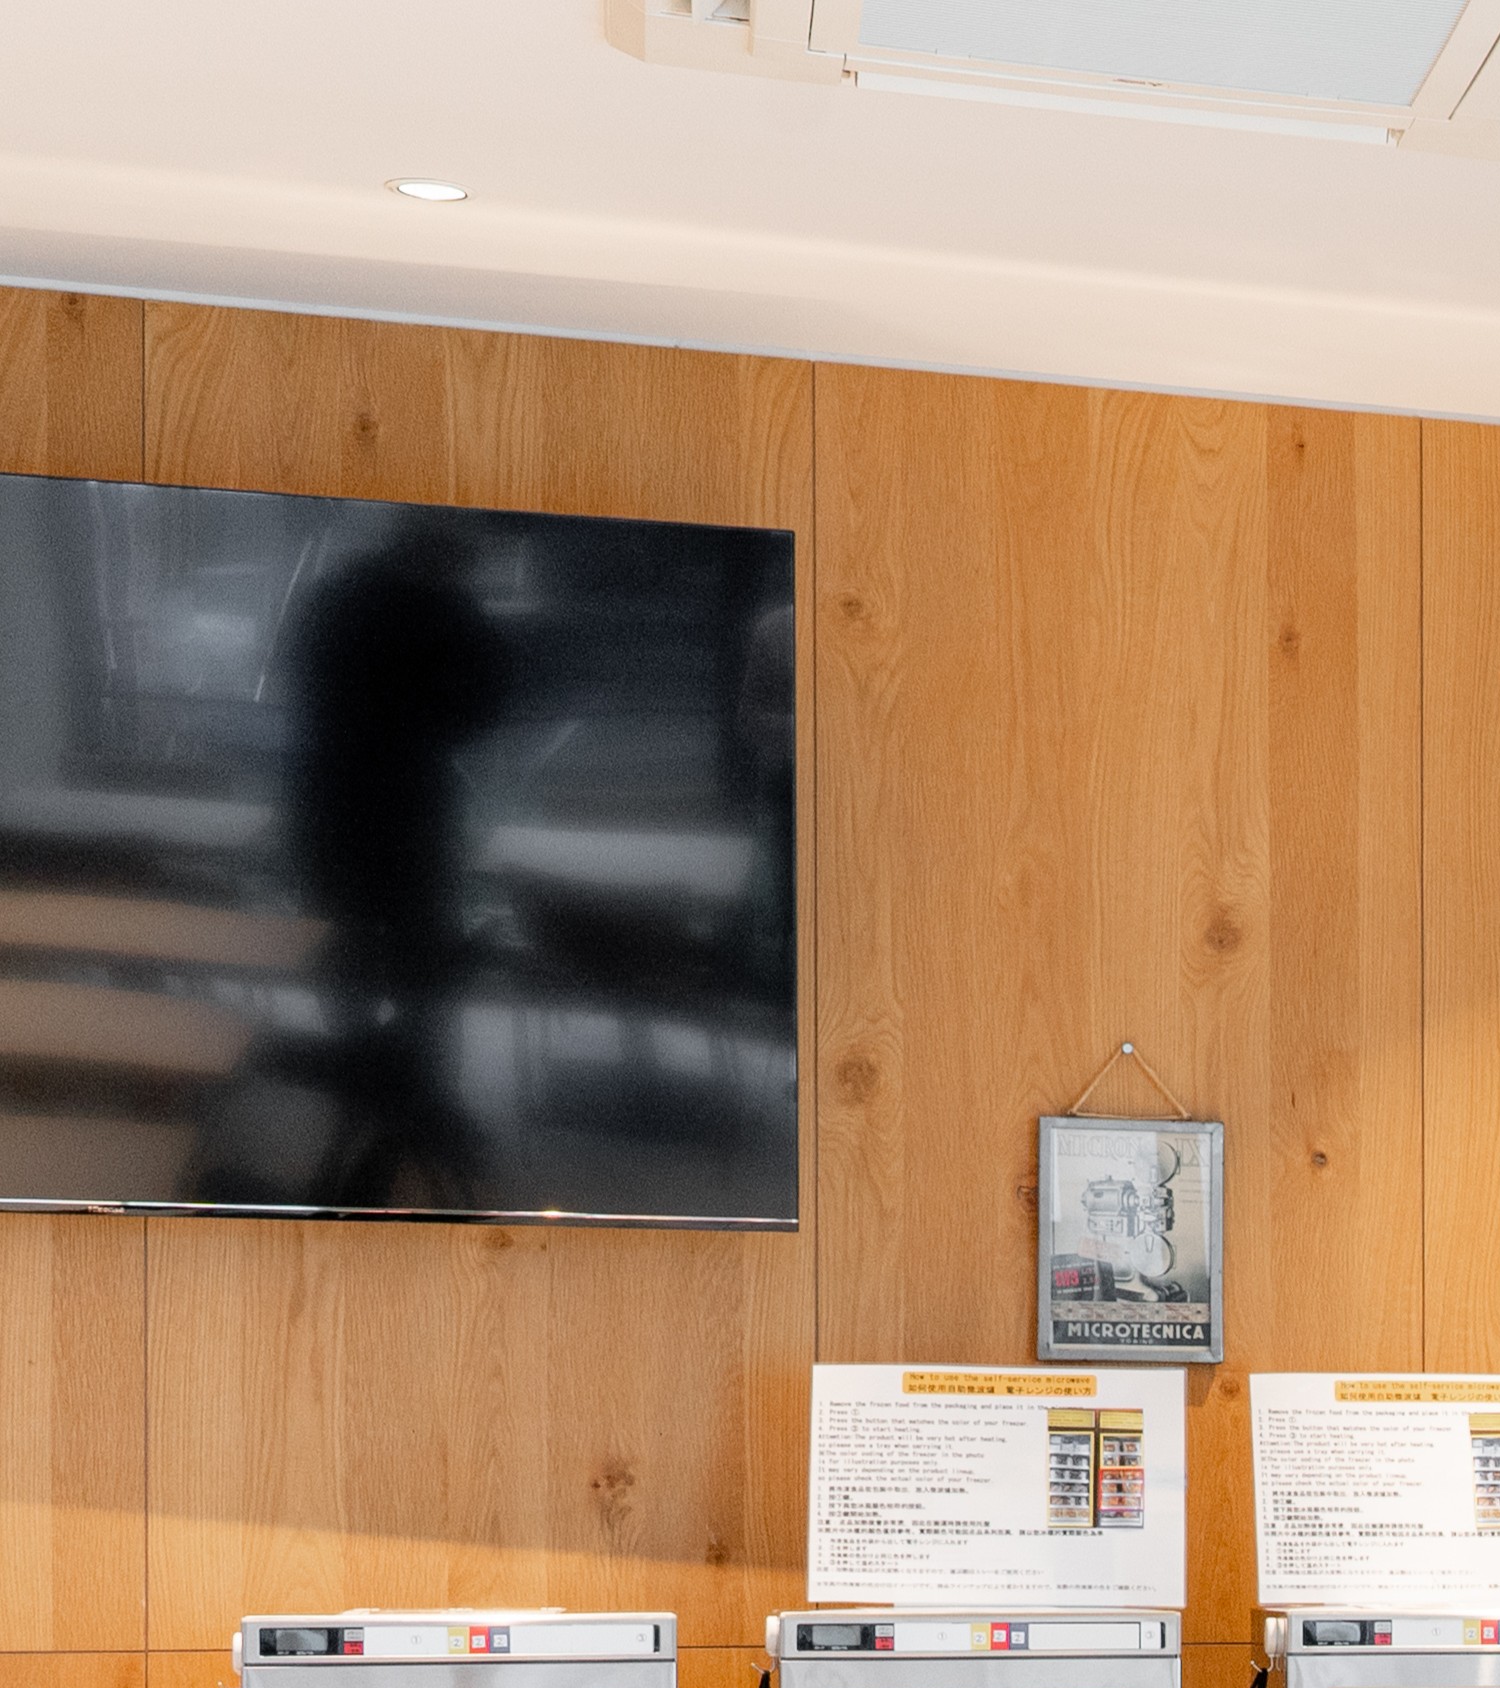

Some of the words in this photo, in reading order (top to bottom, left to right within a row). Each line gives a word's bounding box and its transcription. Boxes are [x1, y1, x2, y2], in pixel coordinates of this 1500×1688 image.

[1067, 1321, 1205, 1340] MICROTECNICA
[983, 1375, 1042, 1384] self-service
[1045, 1376, 1091, 1384] microwave
